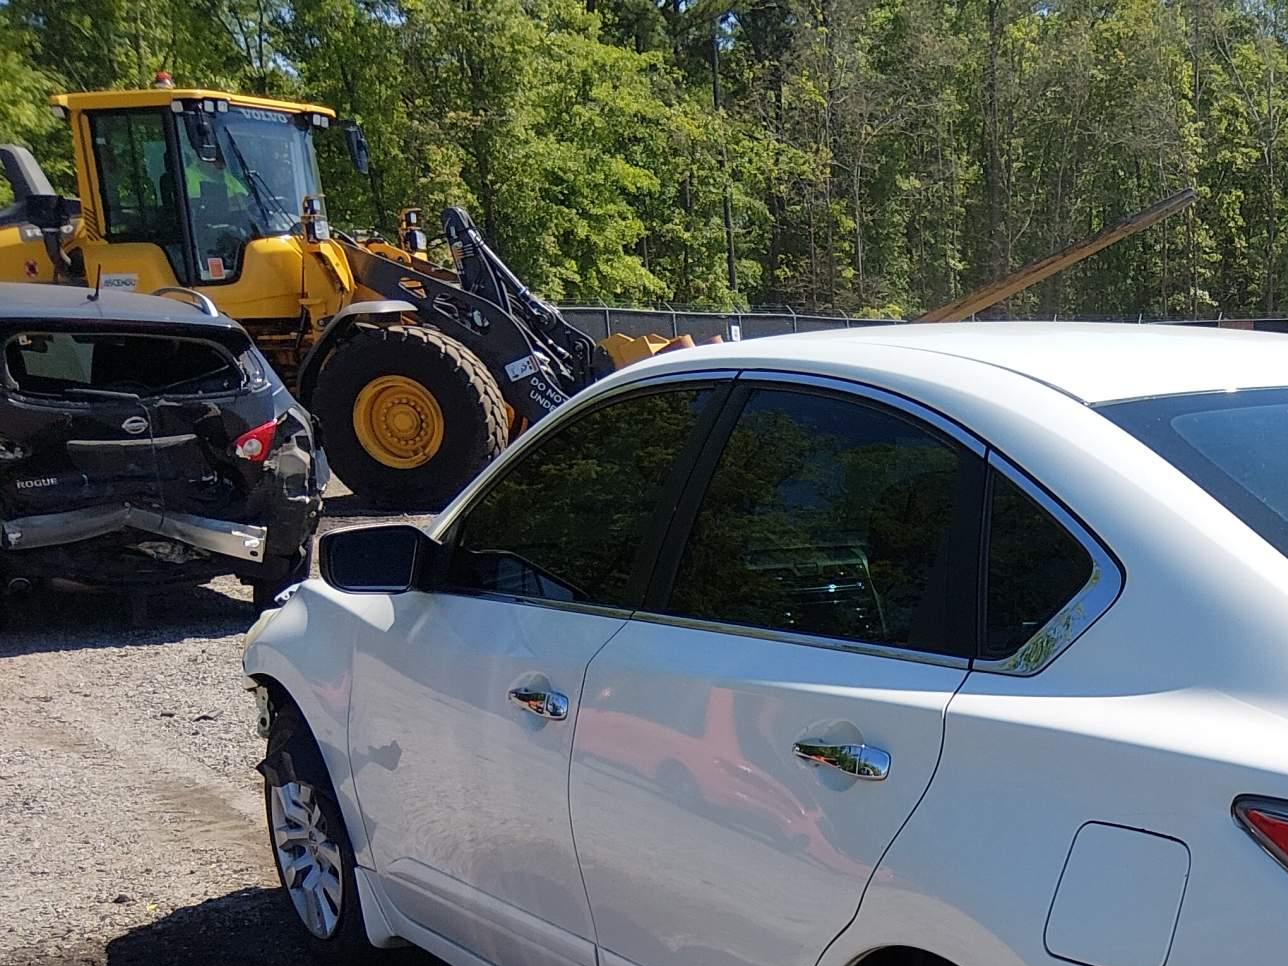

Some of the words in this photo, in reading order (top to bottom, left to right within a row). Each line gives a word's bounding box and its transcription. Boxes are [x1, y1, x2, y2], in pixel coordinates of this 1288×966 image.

[240, 109, 288, 124] VOLVO
[530, 376, 546, 391] DO
[16, 478, 58, 489] ROGUE
